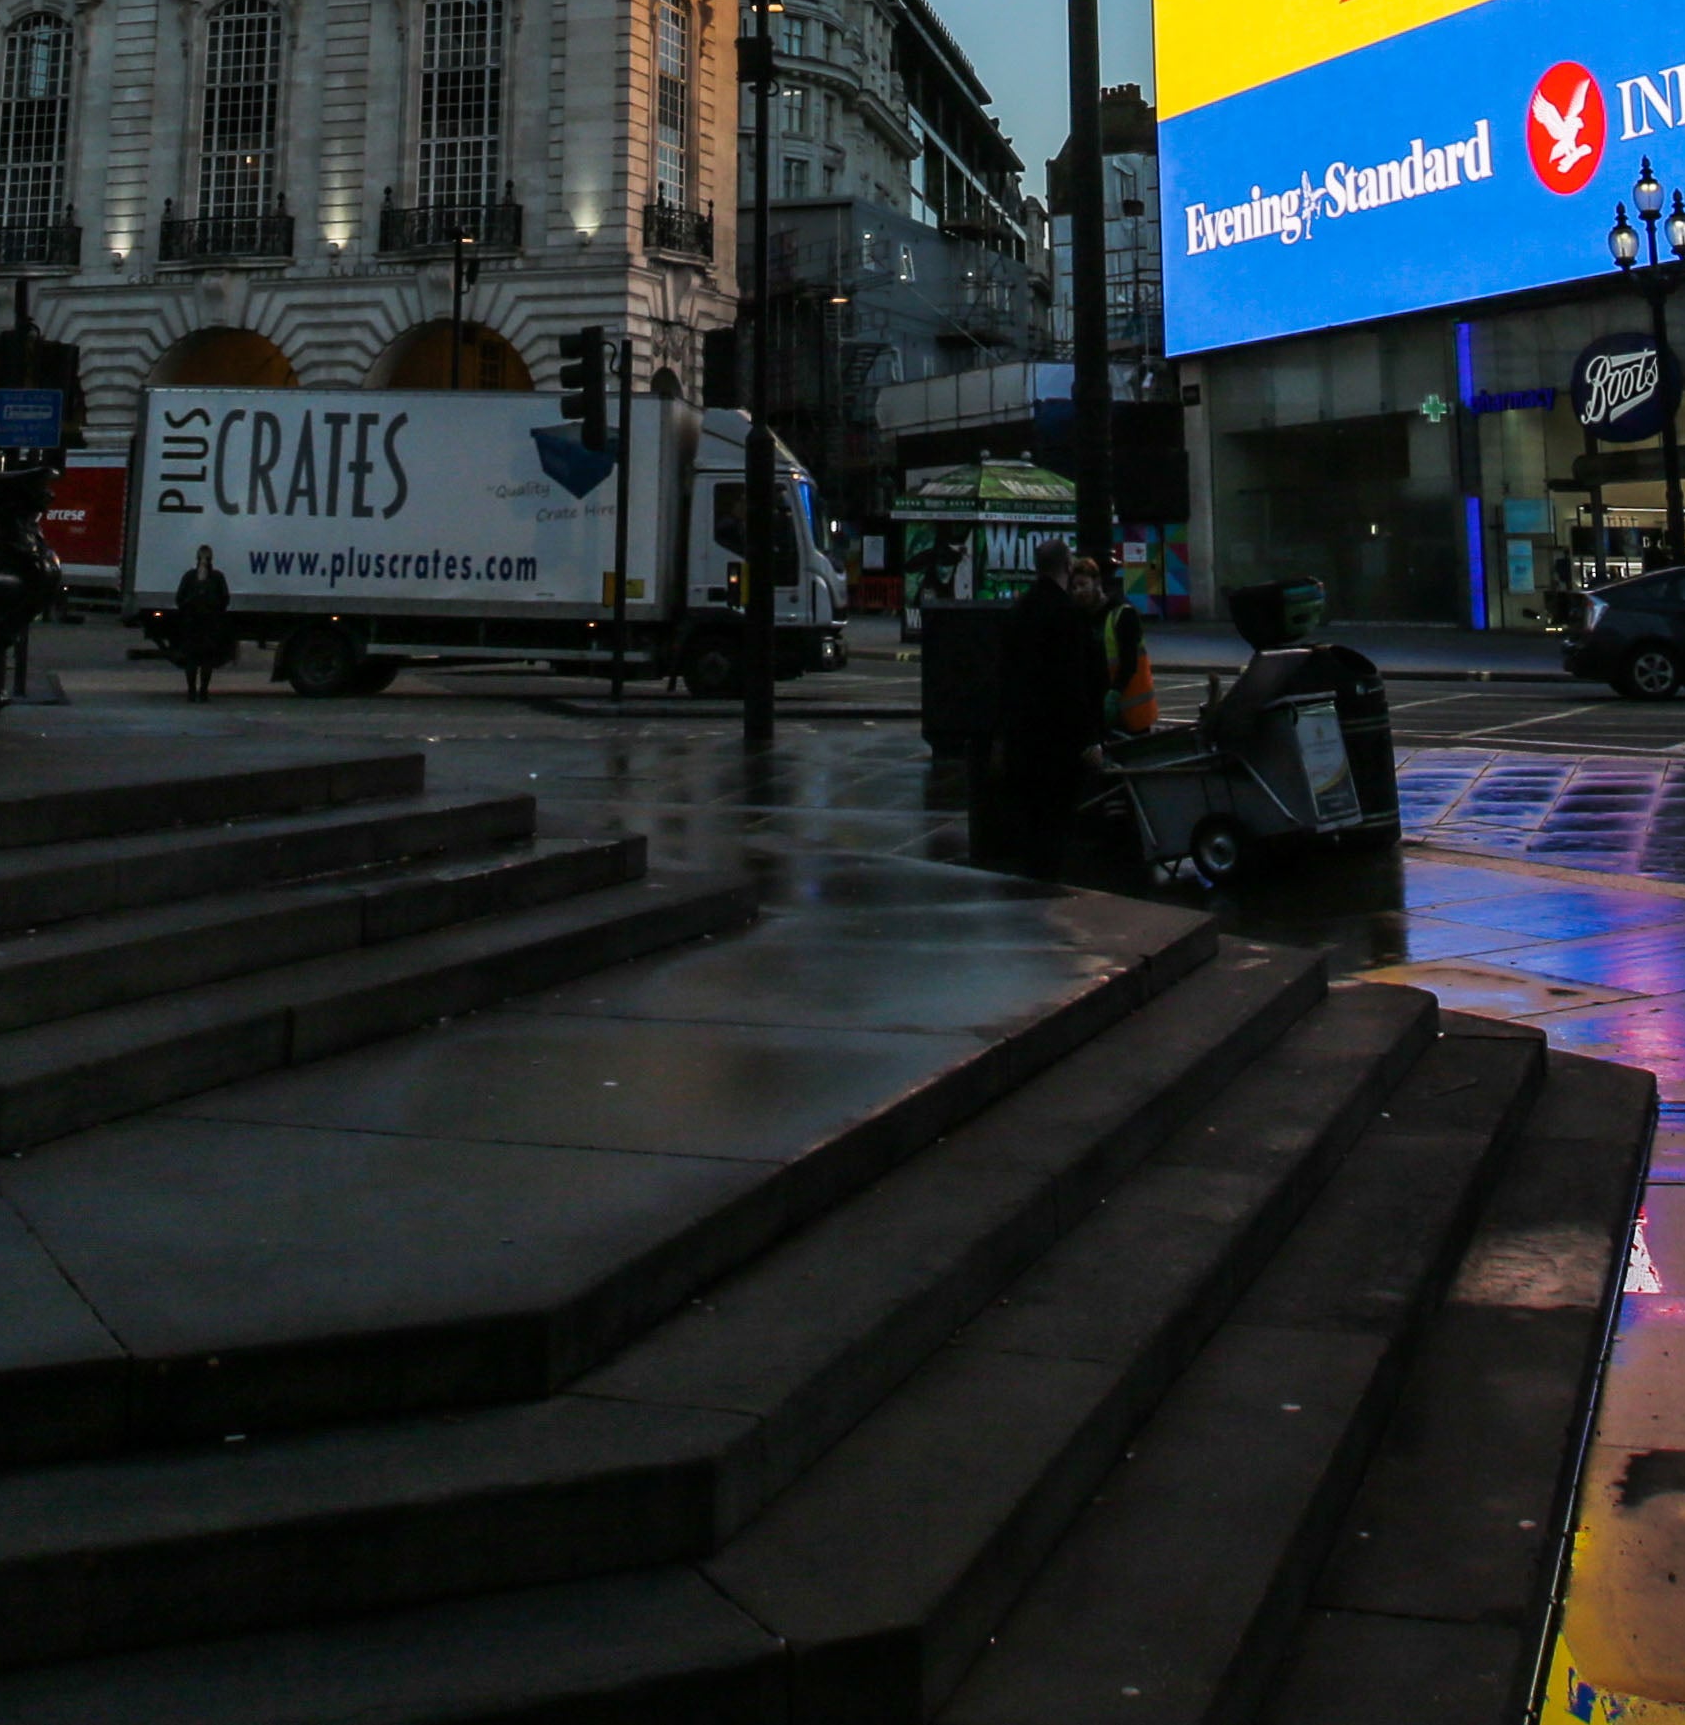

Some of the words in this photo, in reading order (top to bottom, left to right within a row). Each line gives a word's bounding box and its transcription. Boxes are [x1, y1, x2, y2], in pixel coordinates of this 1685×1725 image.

[1185, 185, 1303, 256] Evening
[1324, 118, 1494, 218] Standard
[1471, 387, 1556, 418] pharmacy
[1580, 348, 1659, 425] Boots
[157, 407, 212, 514] PLUS
[213, 408, 410, 520] CRATES
[536, 507, 578, 522] Crate
[248, 546, 538, 589] www.pluscrates.com
